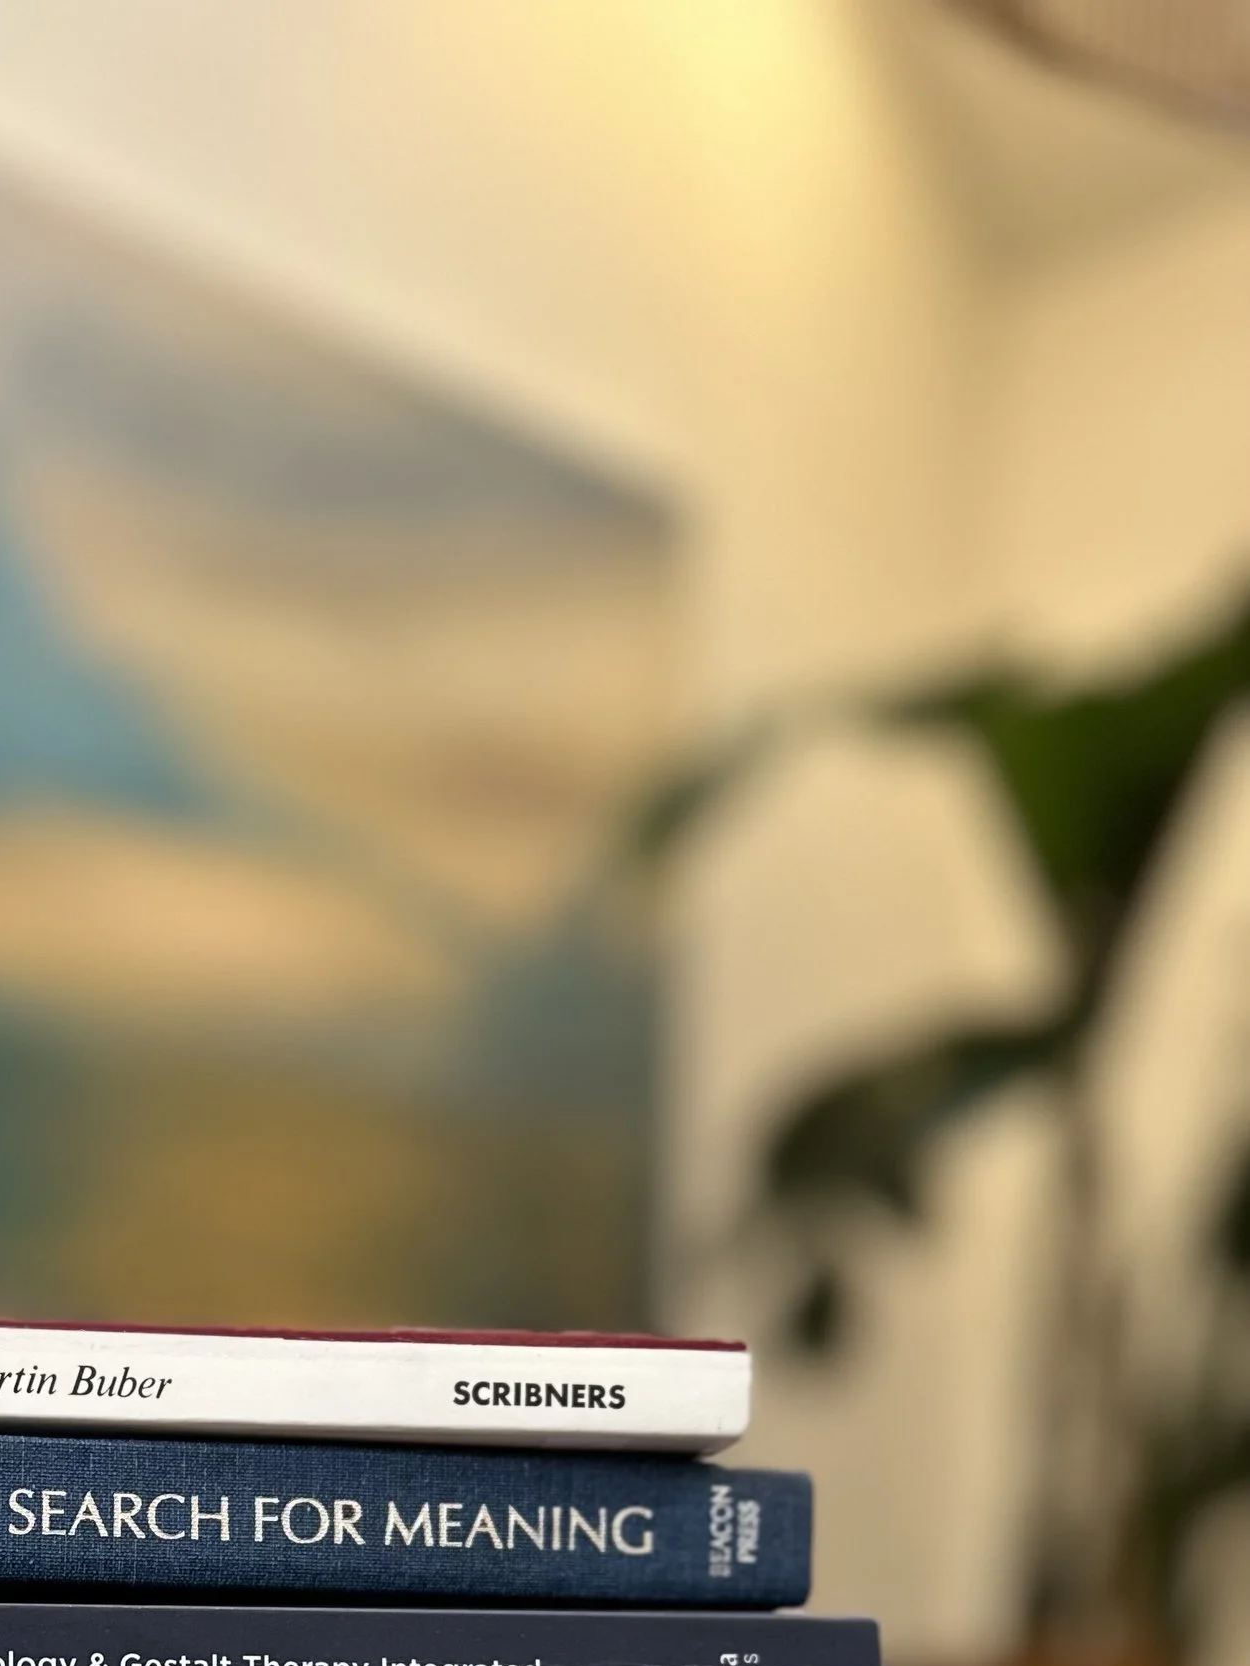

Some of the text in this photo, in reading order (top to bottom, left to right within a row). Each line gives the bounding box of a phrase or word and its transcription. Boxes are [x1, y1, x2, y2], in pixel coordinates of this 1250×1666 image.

[70, 1365, 172, 1402] Buber
[452, 1380, 626, 1410] SCRIBNERS
[9, 1488, 231, 1543] SEARCH
[253, 1496, 364, 1544] FOR
[384, 1501, 655, 1555] MEANING
[710, 1485, 731, 1577] BEACON
[738, 1500, 760, 1563] PRESS
